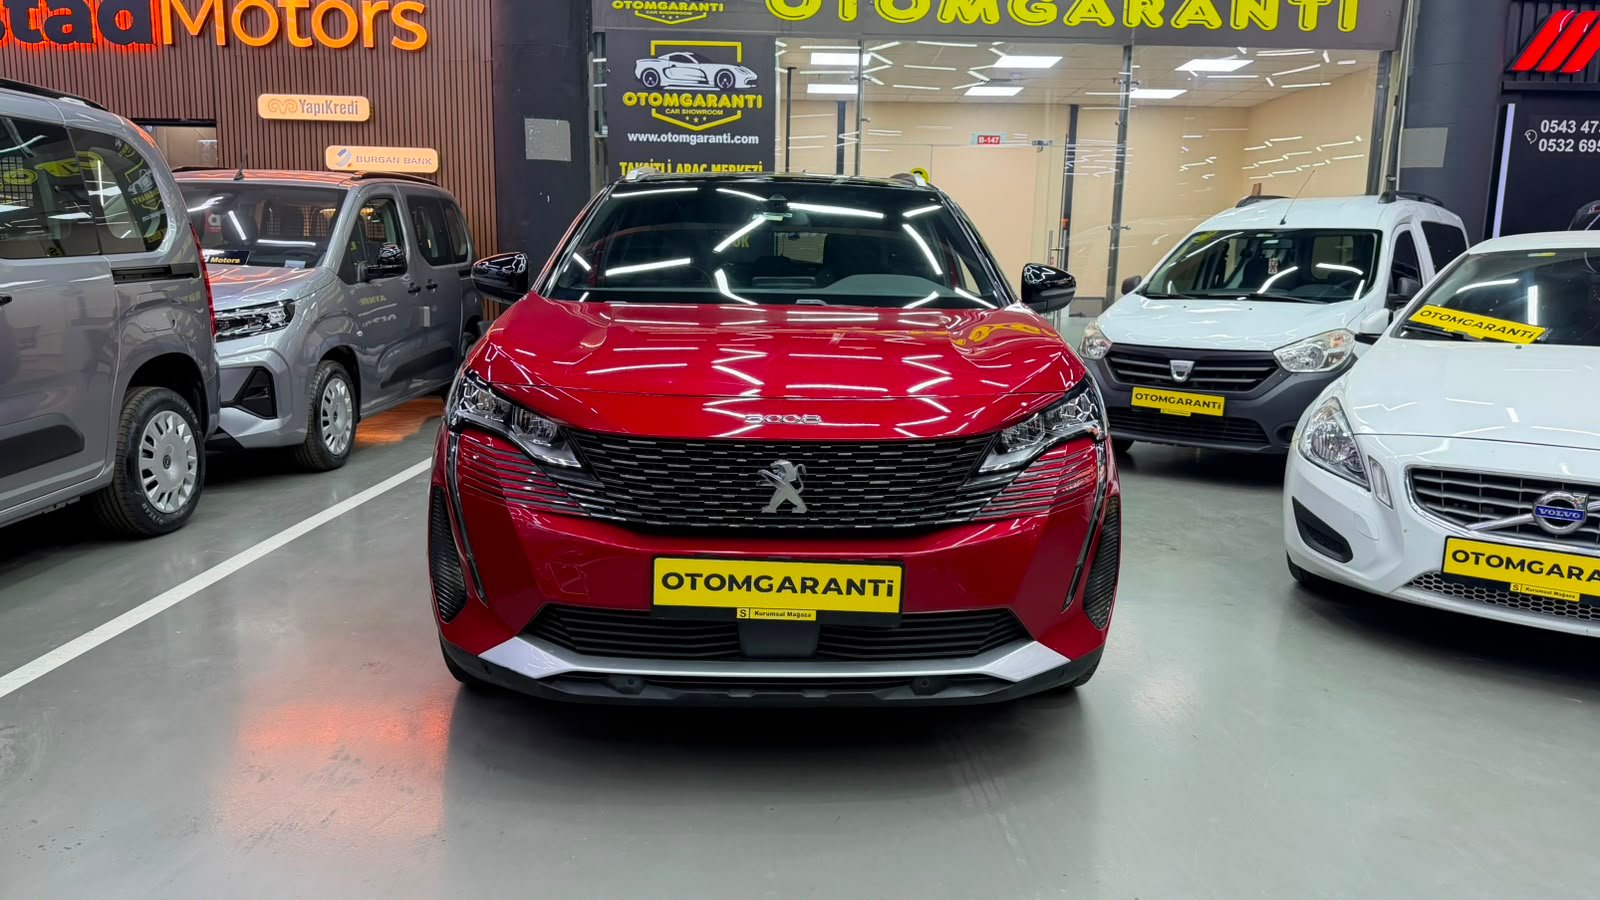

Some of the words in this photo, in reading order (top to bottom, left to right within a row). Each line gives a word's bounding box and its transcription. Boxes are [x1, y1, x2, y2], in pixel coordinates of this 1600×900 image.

[611, 0, 724, 12] OTOMGARANTI
[622, 91, 763, 109] OTOMGARANTI
[681, 108, 724, 116] SHOWROOM
[1540, 119, 1577, 134] 0543
[627, 132, 759, 145] www.otomgaranti.com
[978, 136, 1000, 144] B-147
[1538, 138, 1575, 152] 0532
[355, 155, 400, 164] BURGAN
[403, 156, 432, 165] BANK
[744, 414, 822, 424] 3008
[1538, 507, 1581, 519] VOLVO
[739, 608, 747, 618] S
[787, 611, 812, 619] Mağaza
